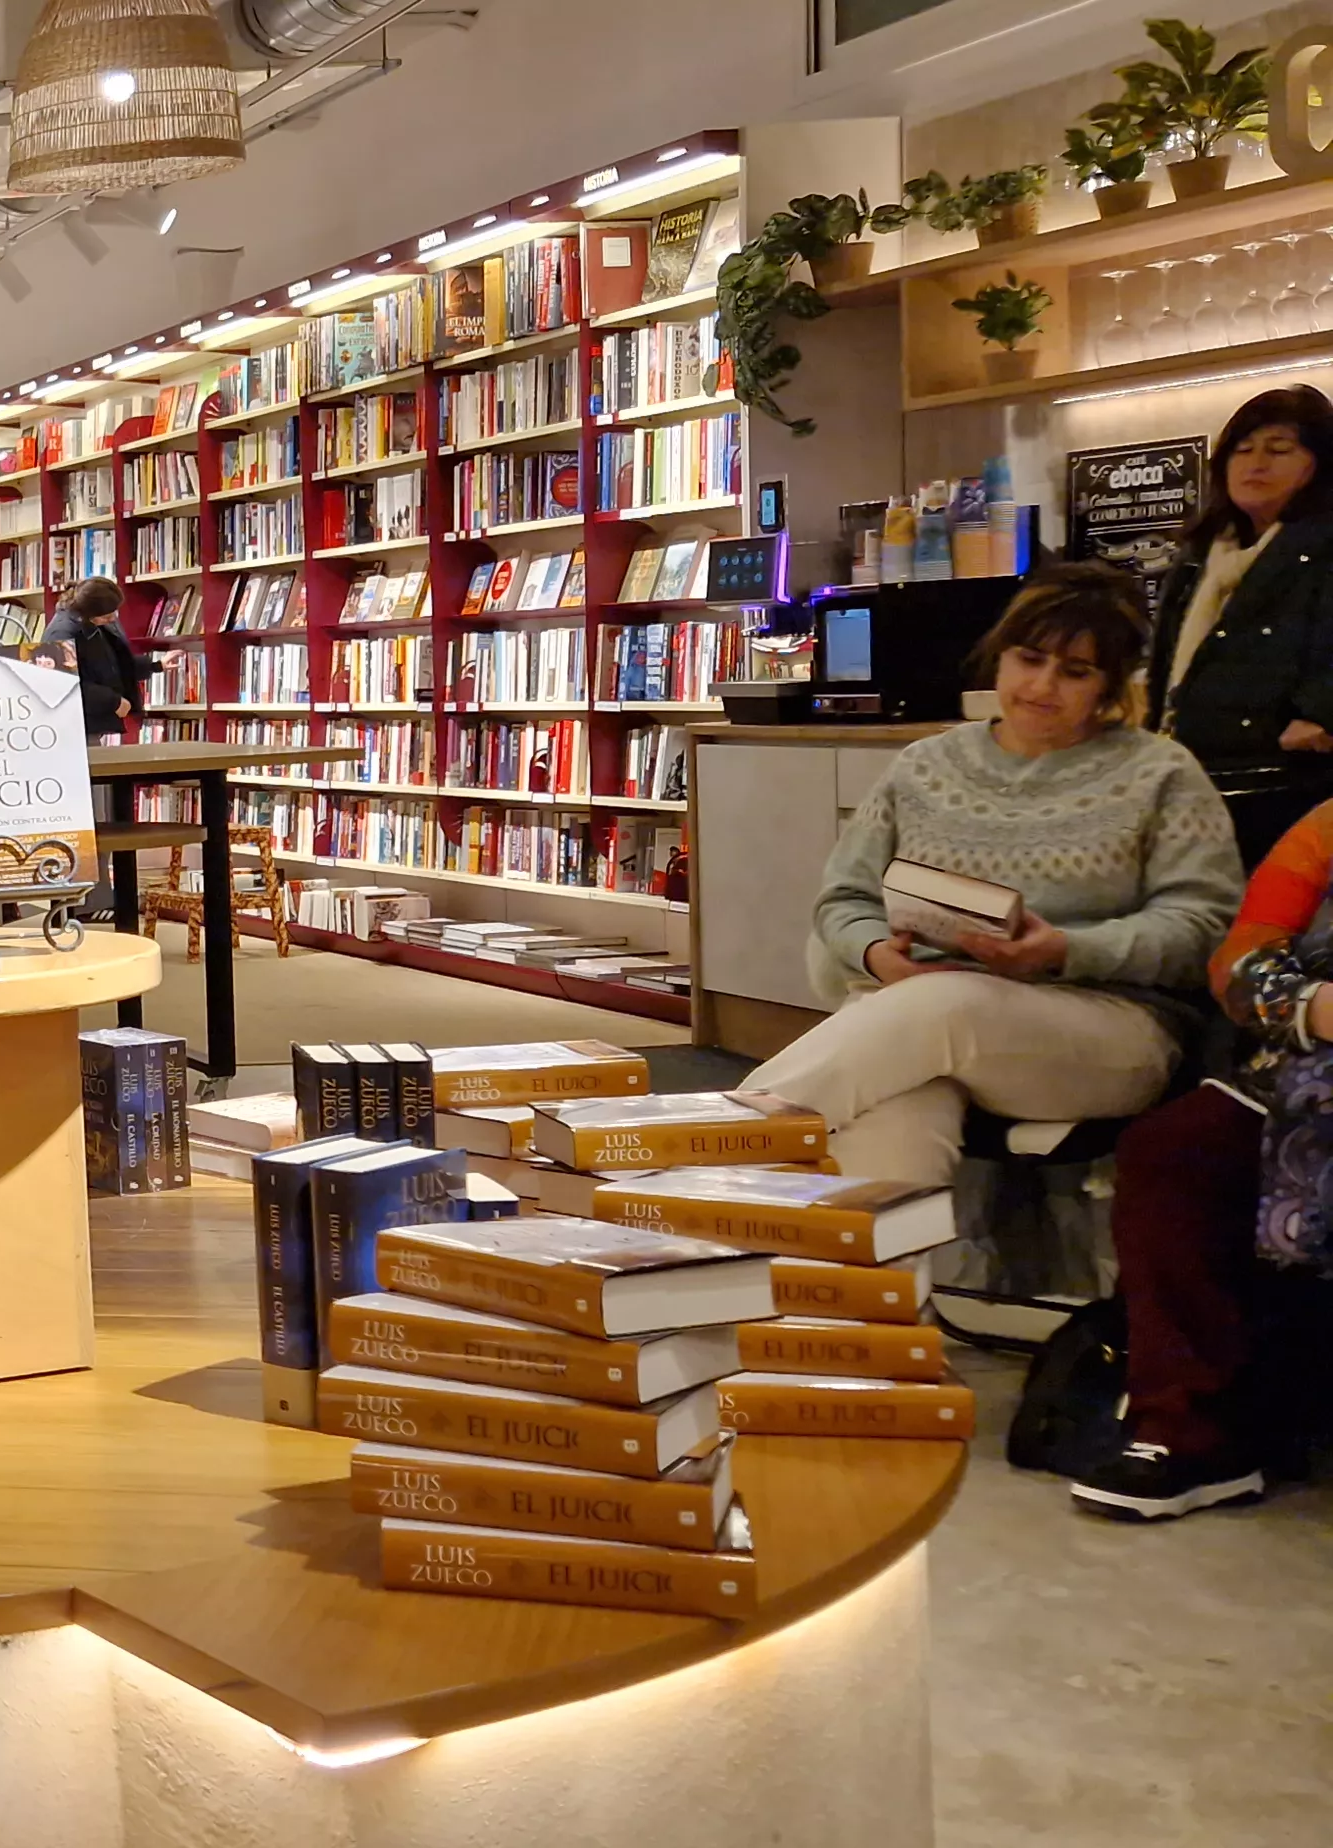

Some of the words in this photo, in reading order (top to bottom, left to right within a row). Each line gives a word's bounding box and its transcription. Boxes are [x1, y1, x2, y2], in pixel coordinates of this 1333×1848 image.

[660, 209, 703, 232] HISTORIA
[1110, 464, 1164, 488] eboca
[49, 814, 73, 823] GOYA
[460, 1076, 491, 1089] LUIS
[533, 1079, 549, 1092] EL
[322, 1078, 338, 1129] ZUECO
[337, 1088, 351, 1119] LUIS
[360, 1077, 376, 1129] ZUECO
[376, 1088, 389, 1120] LUIS
[402, 1076, 418, 1128] ZUECO
[418, 1086, 431, 1118] LUIS
[451, 1088, 501, 1102] ZUECO
[127, 1125, 138, 1168] CASTILLO
[172, 1111, 182, 1168] MONASTERIO
[604, 1133, 641, 1148] LUIS
[690, 1136, 709, 1152] EL
[595, 1148, 653, 1164] ZUECO
[401, 1170, 446, 1204] LUIS
[625, 1202, 661, 1219] LUIS
[613, 1218, 674, 1236] ZUECO
[716, 1219, 733, 1236] EL
[274, 1300, 285, 1356] CASTILLO
[364, 1320, 405, 1342] LUIS
[351, 1338, 420, 1363] ZUECO
[464, 1342, 486, 1364] EL
[356, 1393, 403, 1415] LUIS
[343, 1412, 417, 1437] ZUECO
[467, 1415, 492, 1438] EL
[392, 1471, 441, 1493] LUIS
[378, 1490, 457, 1514] ZUECO
[511, 1492, 535, 1514] EL
[425, 1544, 476, 1566] LUIS
[410, 1564, 493, 1588] ZUECO
[548, 1563, 579, 1587] EL
